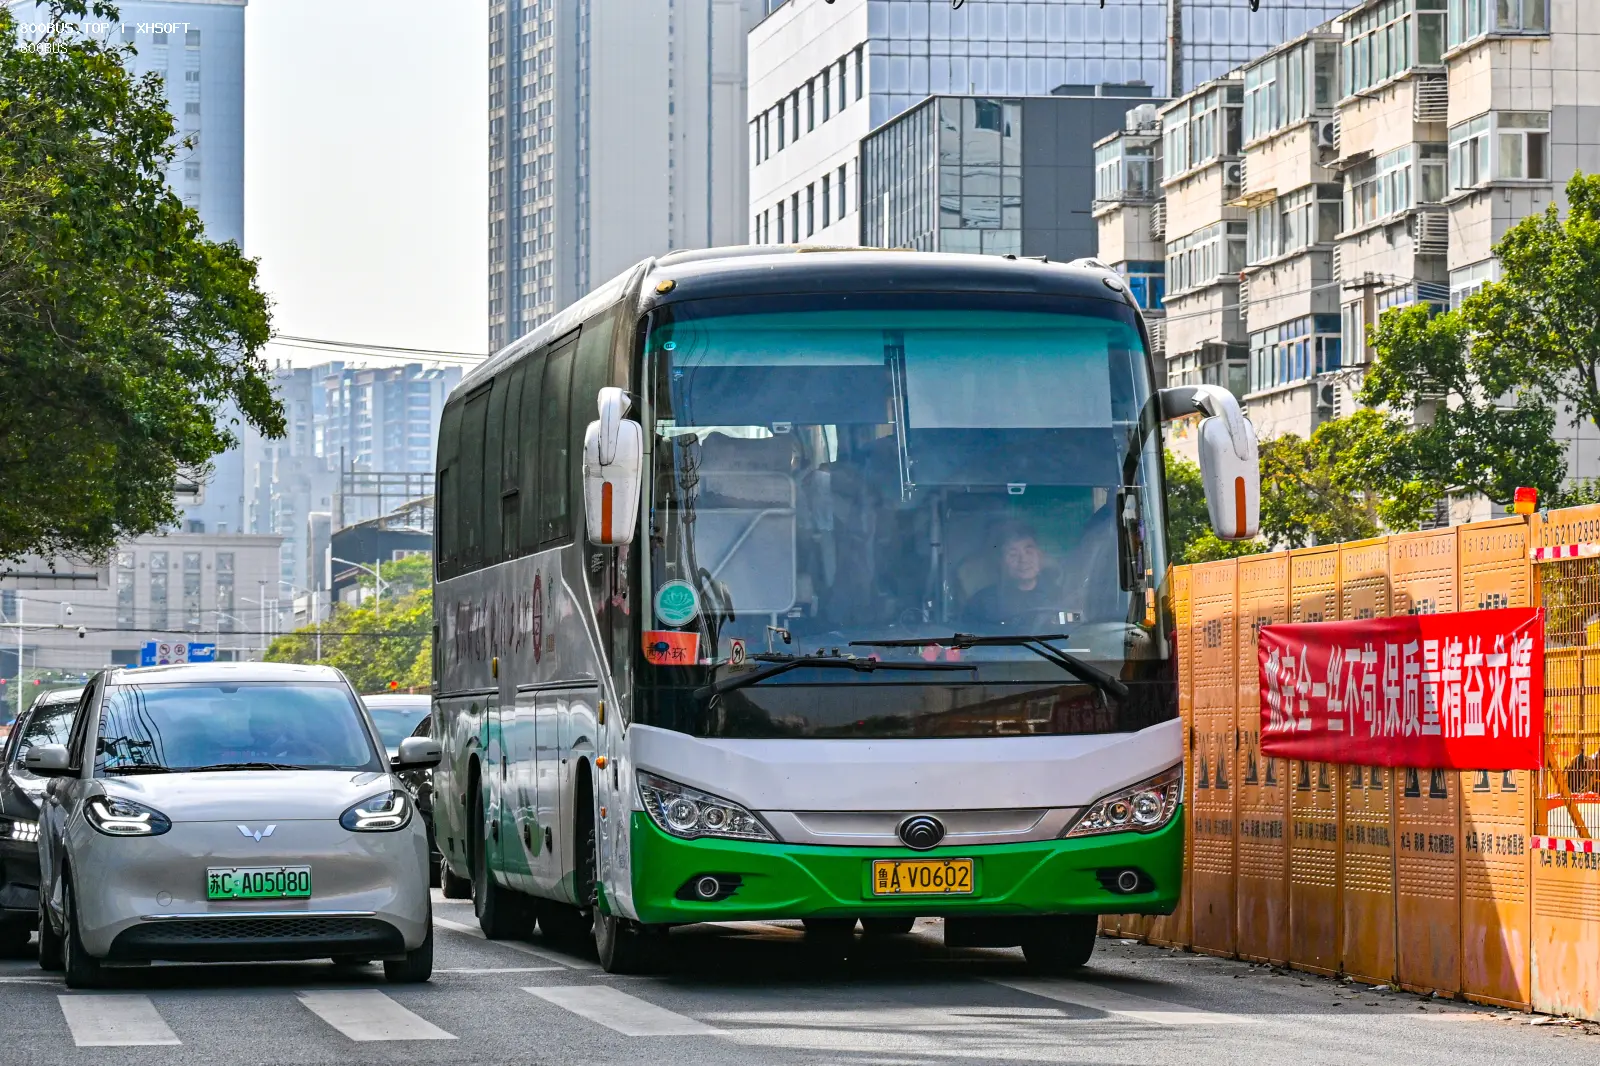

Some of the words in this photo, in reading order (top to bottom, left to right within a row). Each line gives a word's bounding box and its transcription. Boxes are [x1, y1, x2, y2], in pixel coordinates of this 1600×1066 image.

[1463, 533, 1525, 552] 15162112899
[1539, 519, 1600, 547] 15162112899
[1465, 832, 1478, 853] 水马
[1495, 833, 1524, 856] 夹芯板围挡
